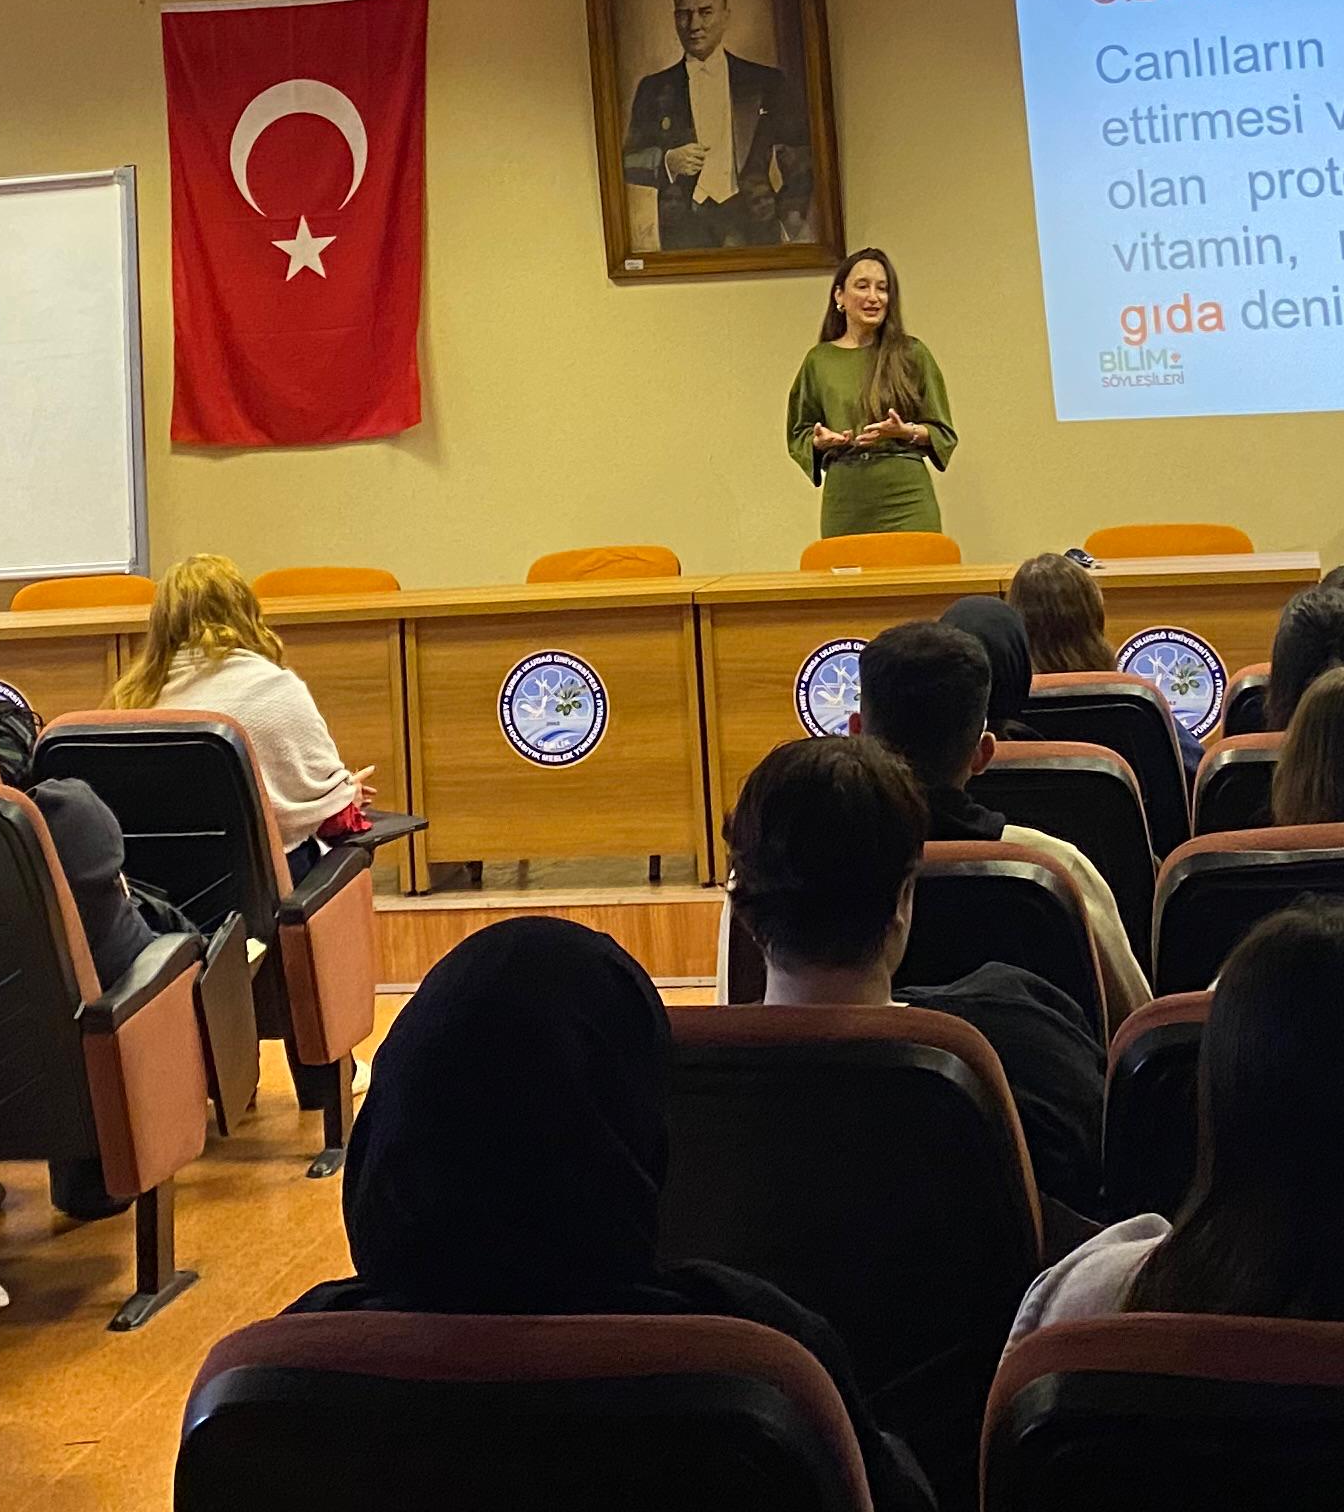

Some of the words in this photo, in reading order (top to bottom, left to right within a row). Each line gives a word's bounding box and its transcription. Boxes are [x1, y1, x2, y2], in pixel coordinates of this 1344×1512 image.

[1096, 36, 1324, 84] Canlıların
[1102, 93, 1304, 146] ettirmesi
[1108, 169, 1207, 210] olan
[1112, 225, 1298, 272] vitamin,
[1120, 292, 1226, 346] gıda
[1101, 371, 1185, 388] SÖYLEŞİLERİ
